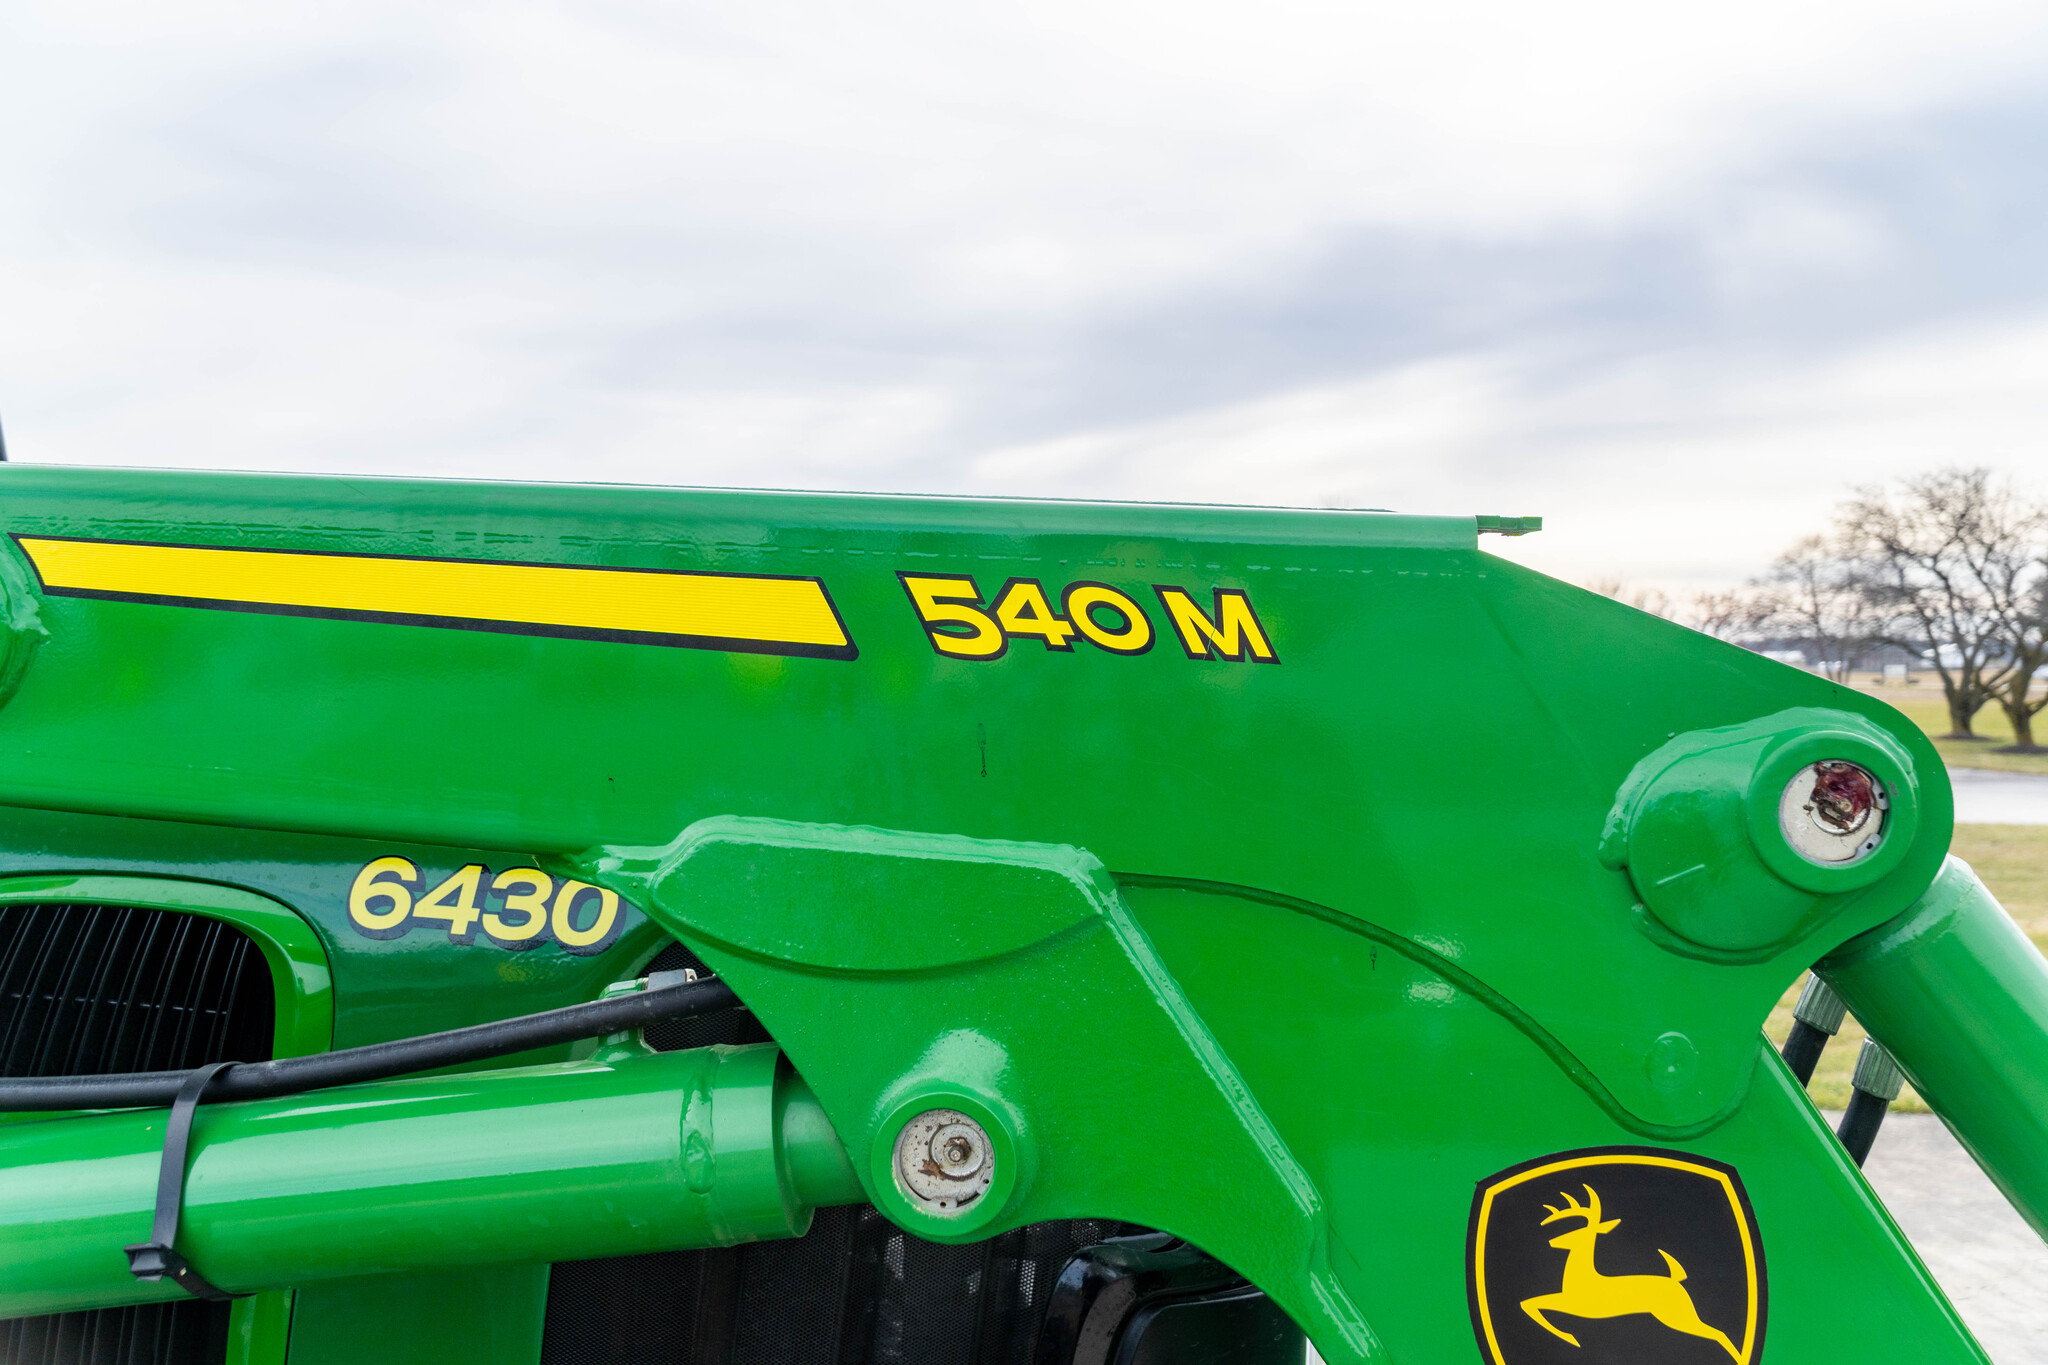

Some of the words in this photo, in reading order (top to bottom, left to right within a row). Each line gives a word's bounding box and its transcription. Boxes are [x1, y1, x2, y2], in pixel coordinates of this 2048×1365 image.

[899, 573, 1151, 658] 540
[1158, 588, 1277, 660] M
[348, 855, 620, 948] 6430
